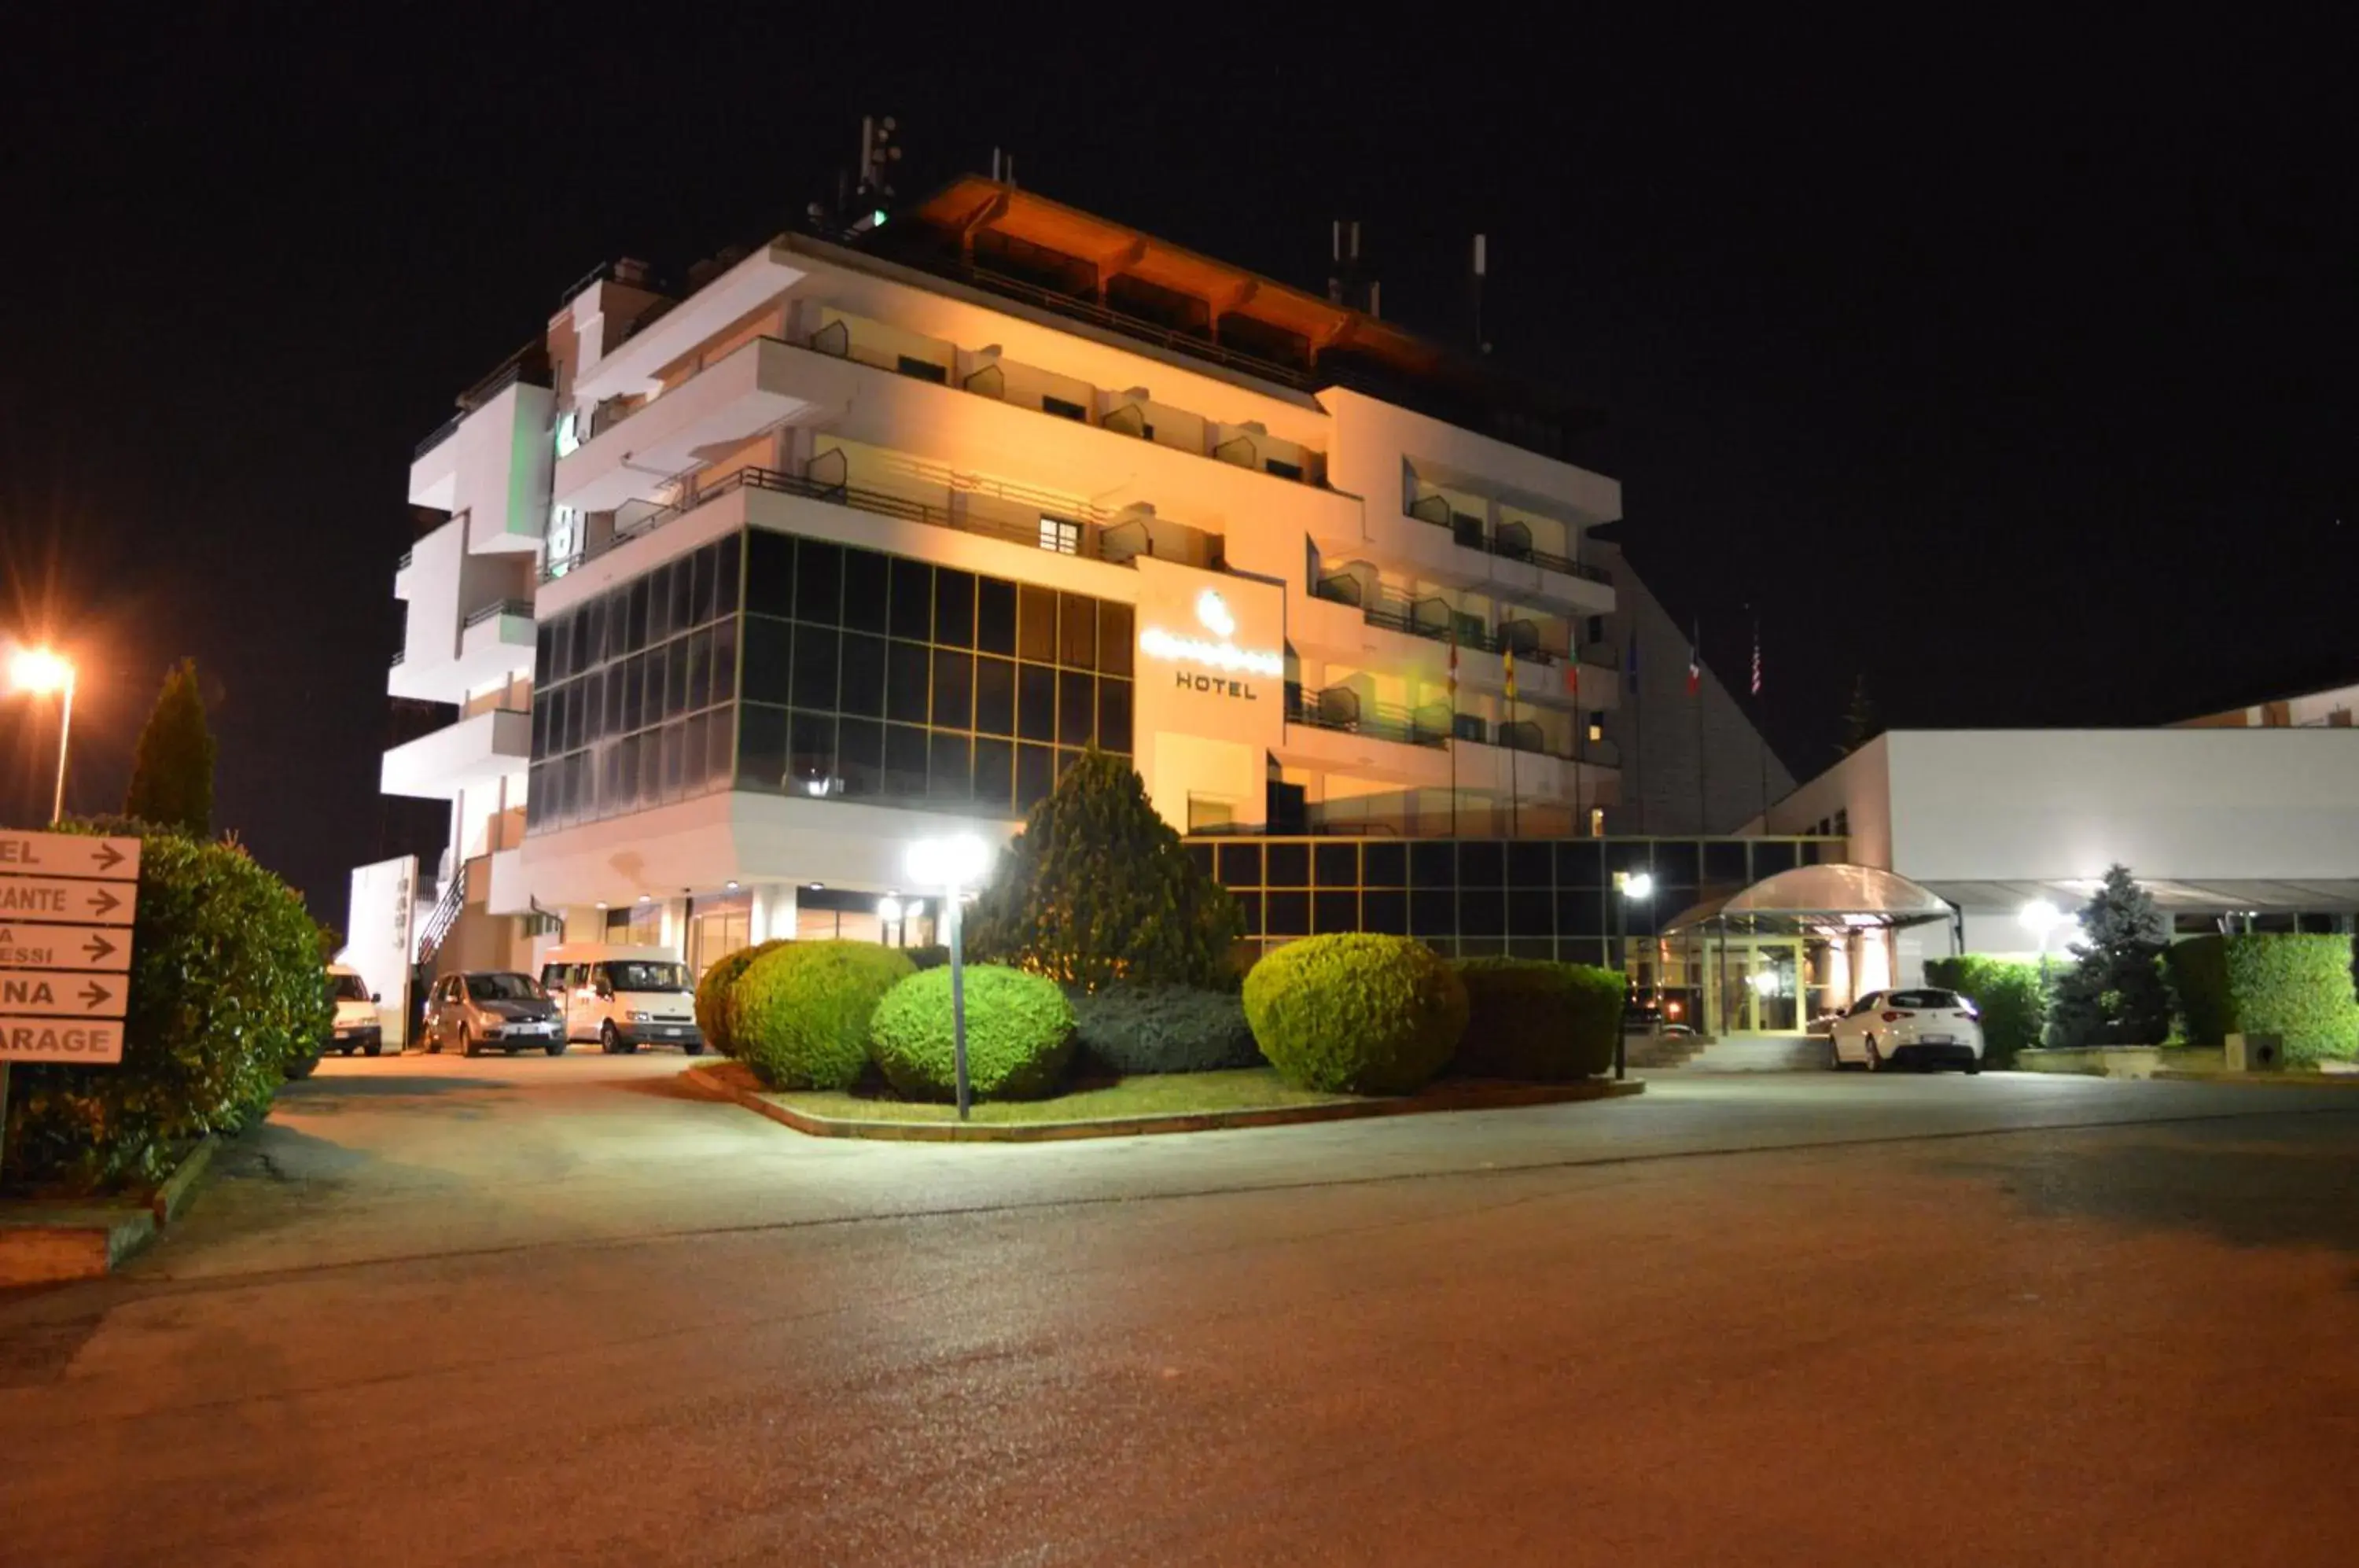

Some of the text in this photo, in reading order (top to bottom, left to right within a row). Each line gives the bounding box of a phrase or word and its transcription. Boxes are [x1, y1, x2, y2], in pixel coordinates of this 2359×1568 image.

[1176, 671, 1257, 700] HOTEL
[0, 841, 40, 863] EL
[0, 886, 66, 911] ANTE
[4, 981, 54, 1004] NA
